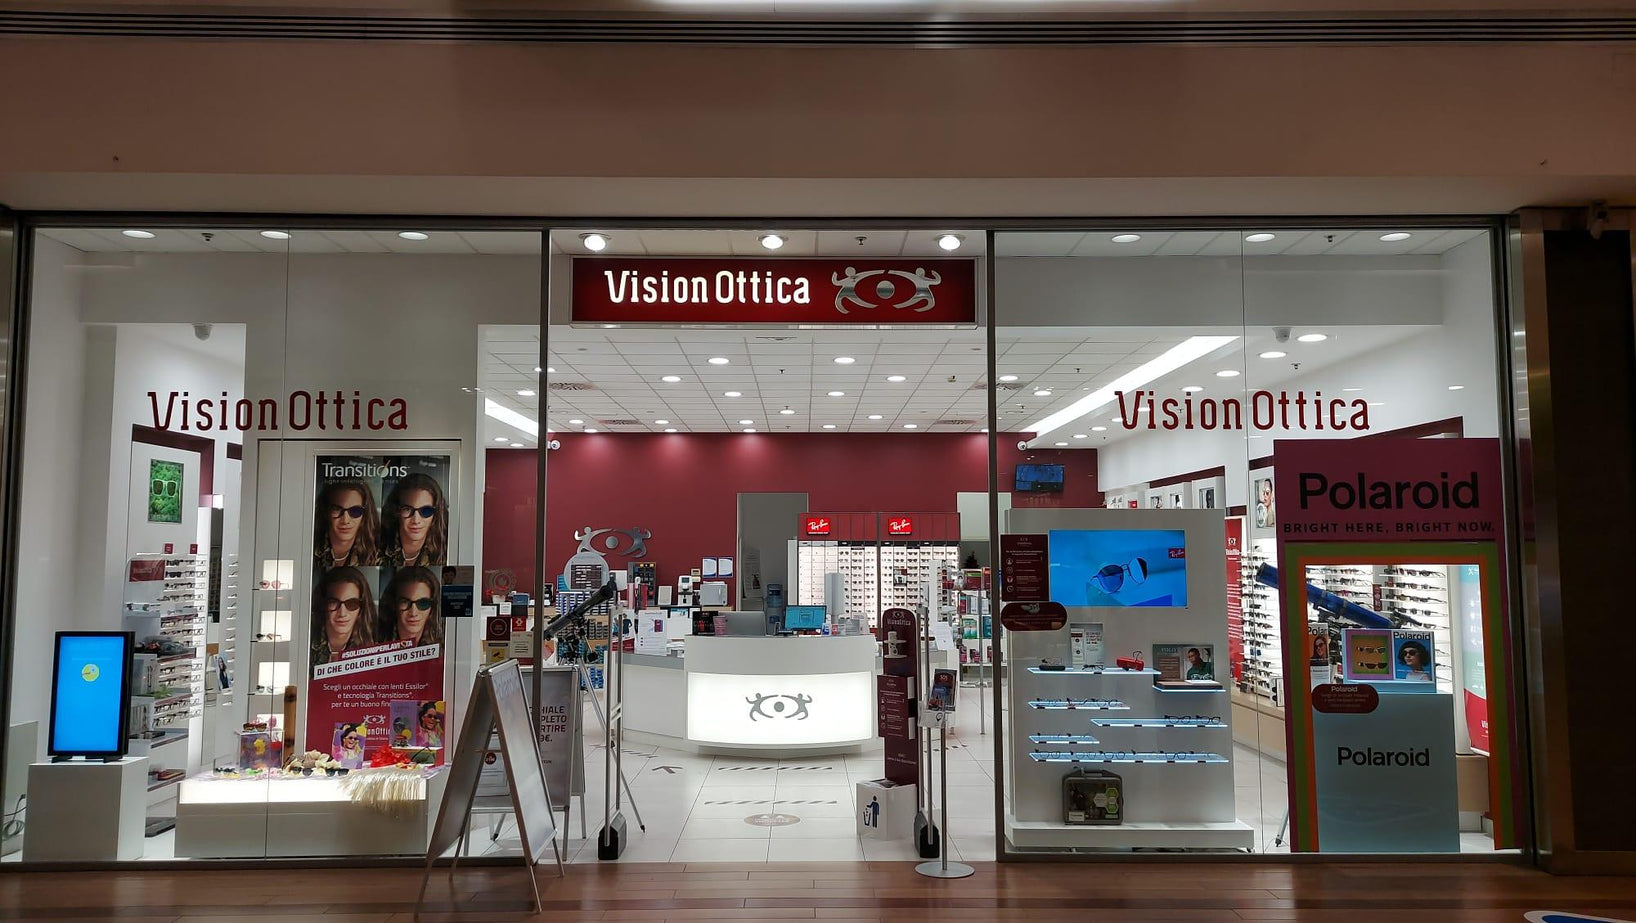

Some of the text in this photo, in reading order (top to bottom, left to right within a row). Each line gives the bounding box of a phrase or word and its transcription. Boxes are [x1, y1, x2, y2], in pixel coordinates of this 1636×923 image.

[321, 460, 409, 478] Transitions
[1299, 471, 1480, 510] Polaroid
[1284, 521, 1496, 534] BRIGHT HERE, BRIGHT NOW.
[1393, 631, 1431, 640] Polaroid
[317, 667, 325, 676] DI
[327, 665, 342, 674] CHE
[345, 659, 375, 671] COLORE
[384, 655, 391, 664] IL
[393, 652, 408, 662] TUO
[410, 647, 436, 659] STILE?
[323, 683, 341, 691] Scegli
[1337, 747, 1430, 767] Polaroid
